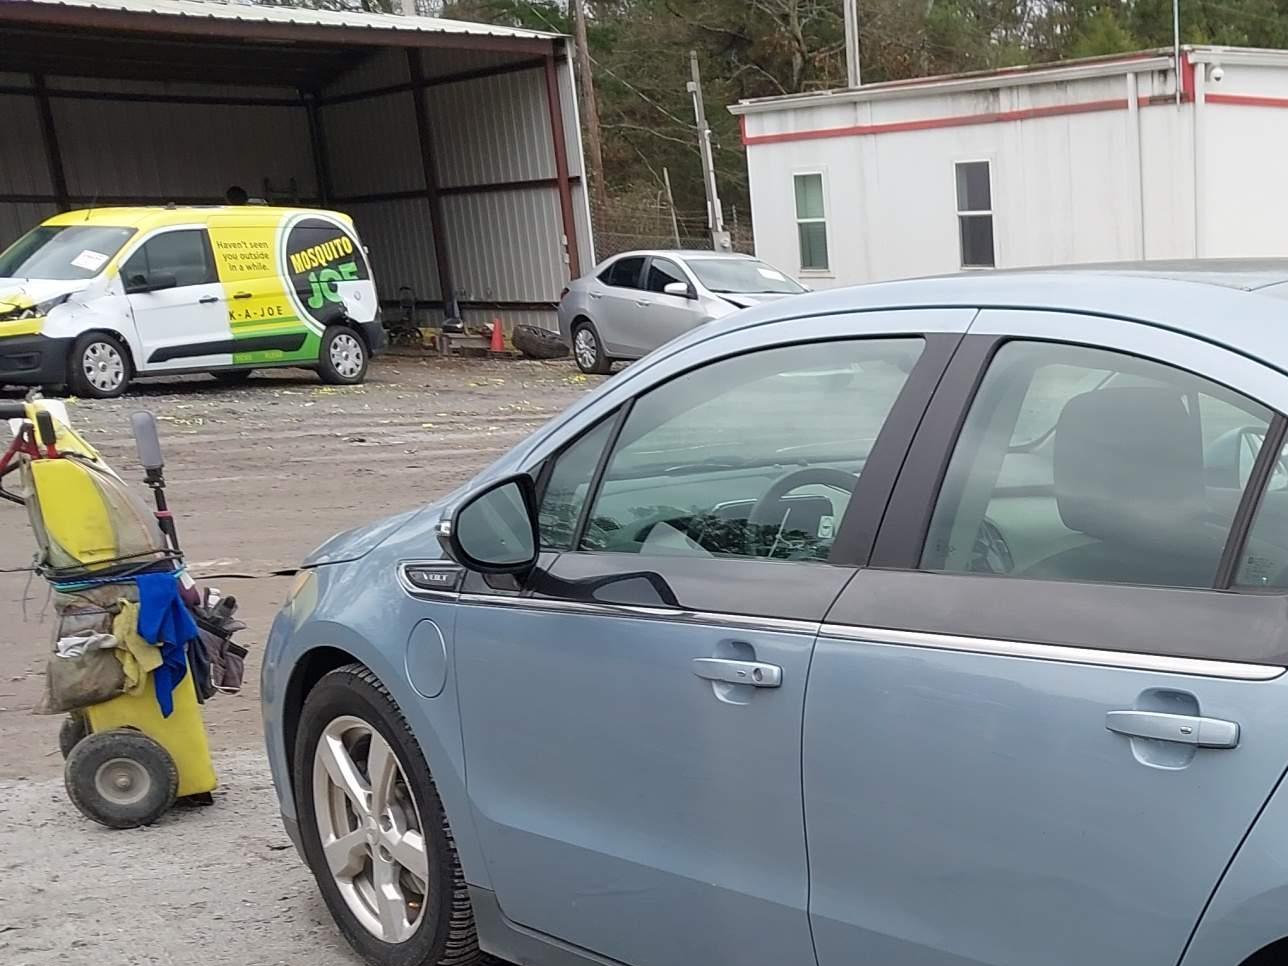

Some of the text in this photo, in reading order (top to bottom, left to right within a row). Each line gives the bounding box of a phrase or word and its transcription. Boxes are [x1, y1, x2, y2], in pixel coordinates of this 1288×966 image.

[216, 240, 269, 250] Haven't seen
[222, 251, 269, 262] you outside
[290, 236, 353, 274] MOSQUITO
[229, 262, 238, 271] in
[247, 260, 270, 271] while.
